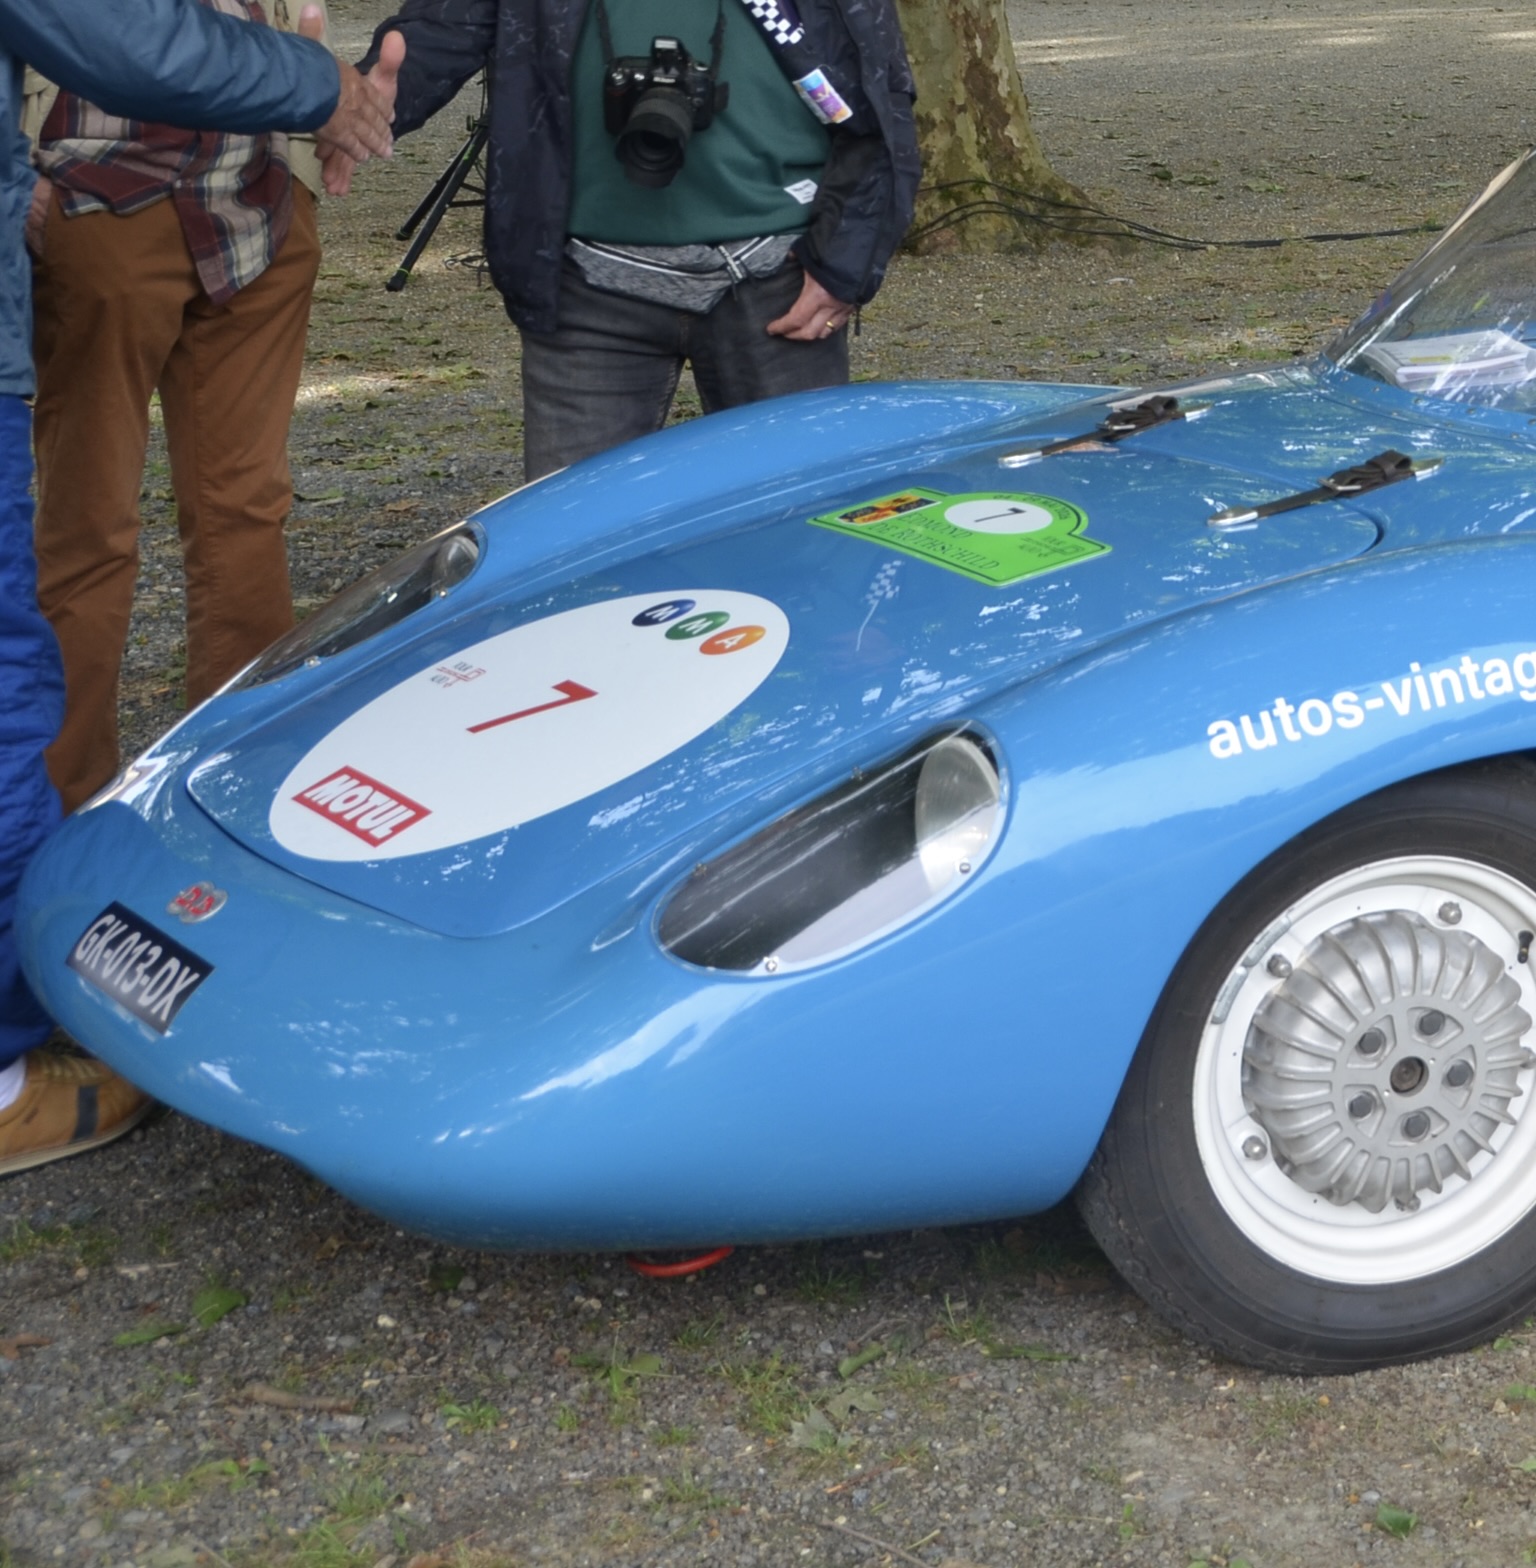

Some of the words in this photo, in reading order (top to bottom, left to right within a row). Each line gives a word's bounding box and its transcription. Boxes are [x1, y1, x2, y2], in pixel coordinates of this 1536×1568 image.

[974, 507, 1027, 523] 7
[465, 678, 599, 734] 7
[303, 773, 416, 839] MOTUL
[75, 914, 201, 1022] GK-013-DX
